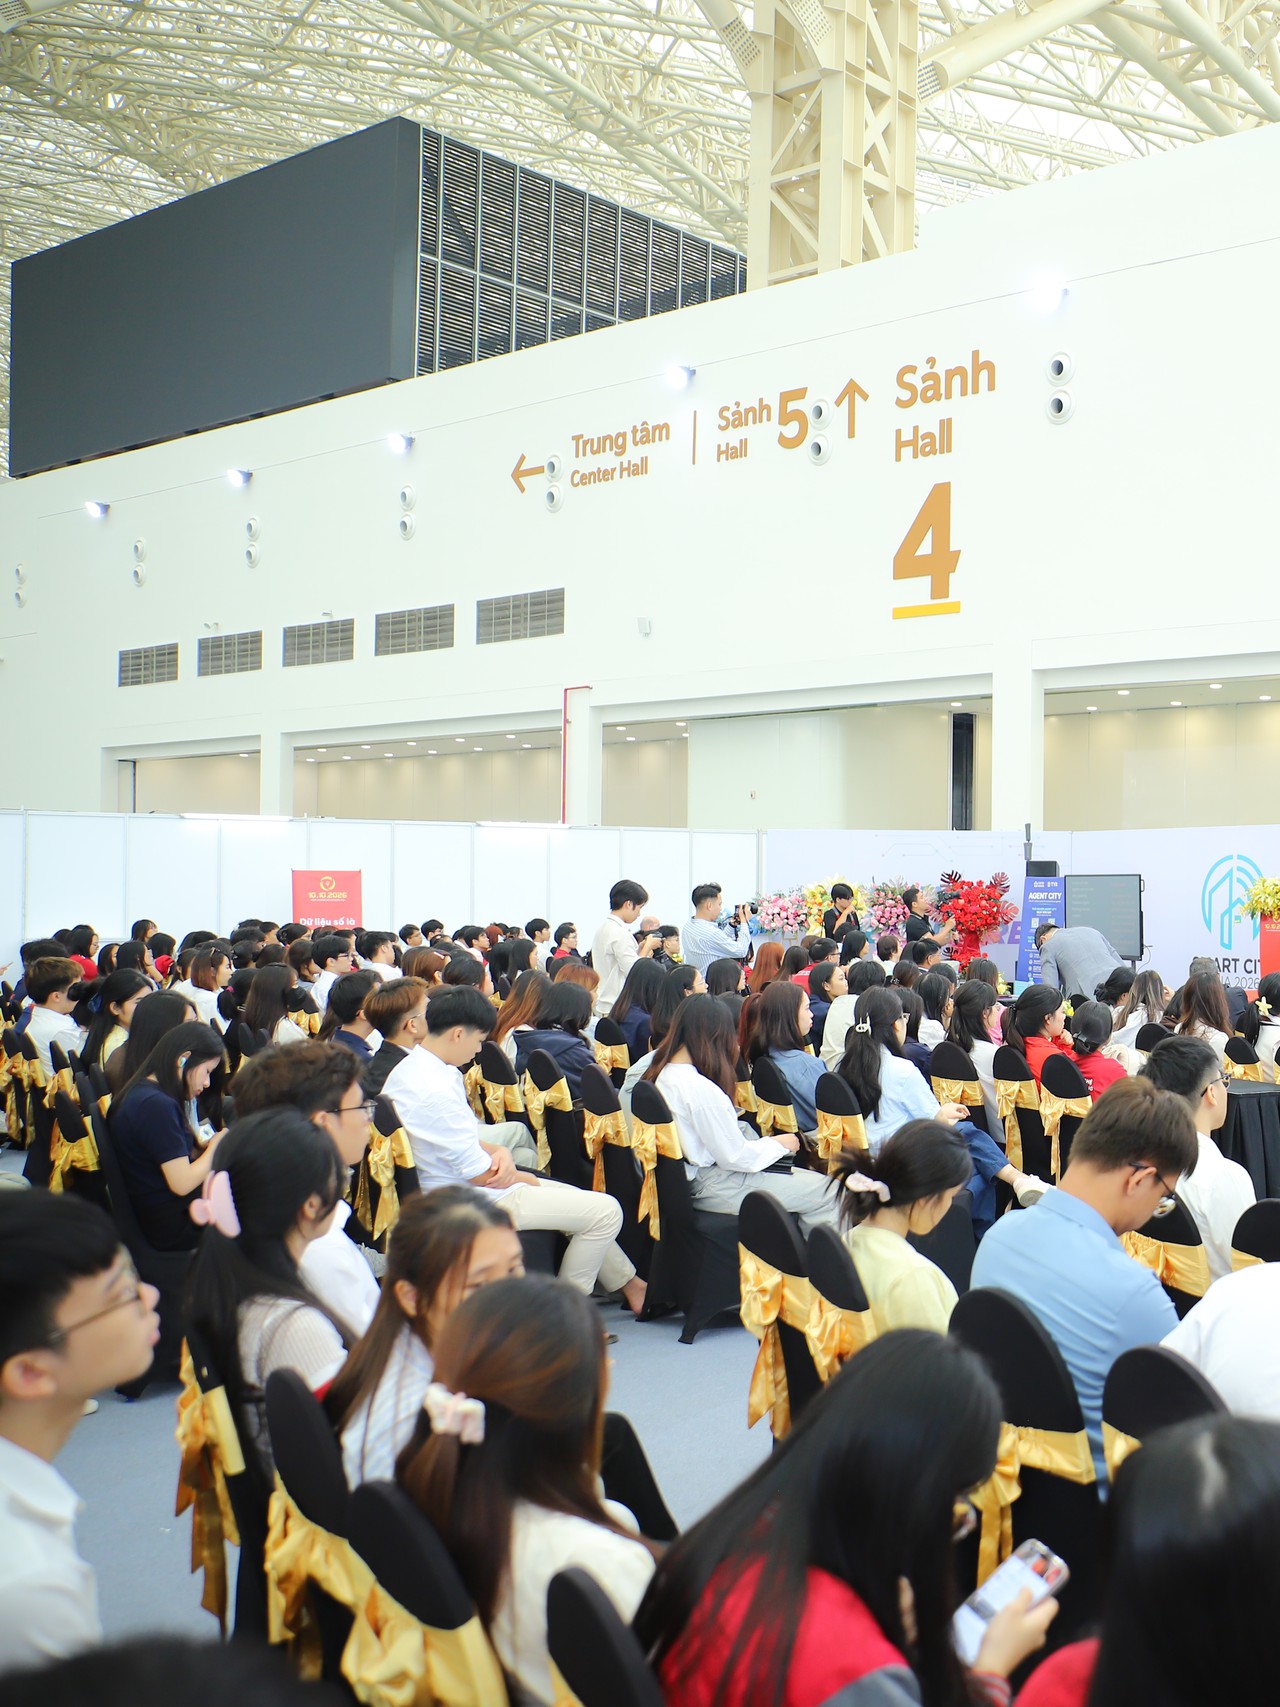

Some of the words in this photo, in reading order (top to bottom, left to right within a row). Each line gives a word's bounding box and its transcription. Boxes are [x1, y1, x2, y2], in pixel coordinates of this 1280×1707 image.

[895, 350, 996, 408] Sảnh
[718, 398, 771, 432] Sảnh
[777, 387, 808, 449] 5
[571, 430, 627, 459] Trung
[631, 419, 670, 448] tâm
[716, 438, 748, 462] Hall
[895, 418, 953, 462] Hall
[570, 462, 616, 487] Center
[619, 456, 648, 480] Hall
[893, 481, 962, 600] 4
[315, 918, 331, 927] liệu
[334, 917, 344, 925] số
[1244, 959, 1260, 974] CI
